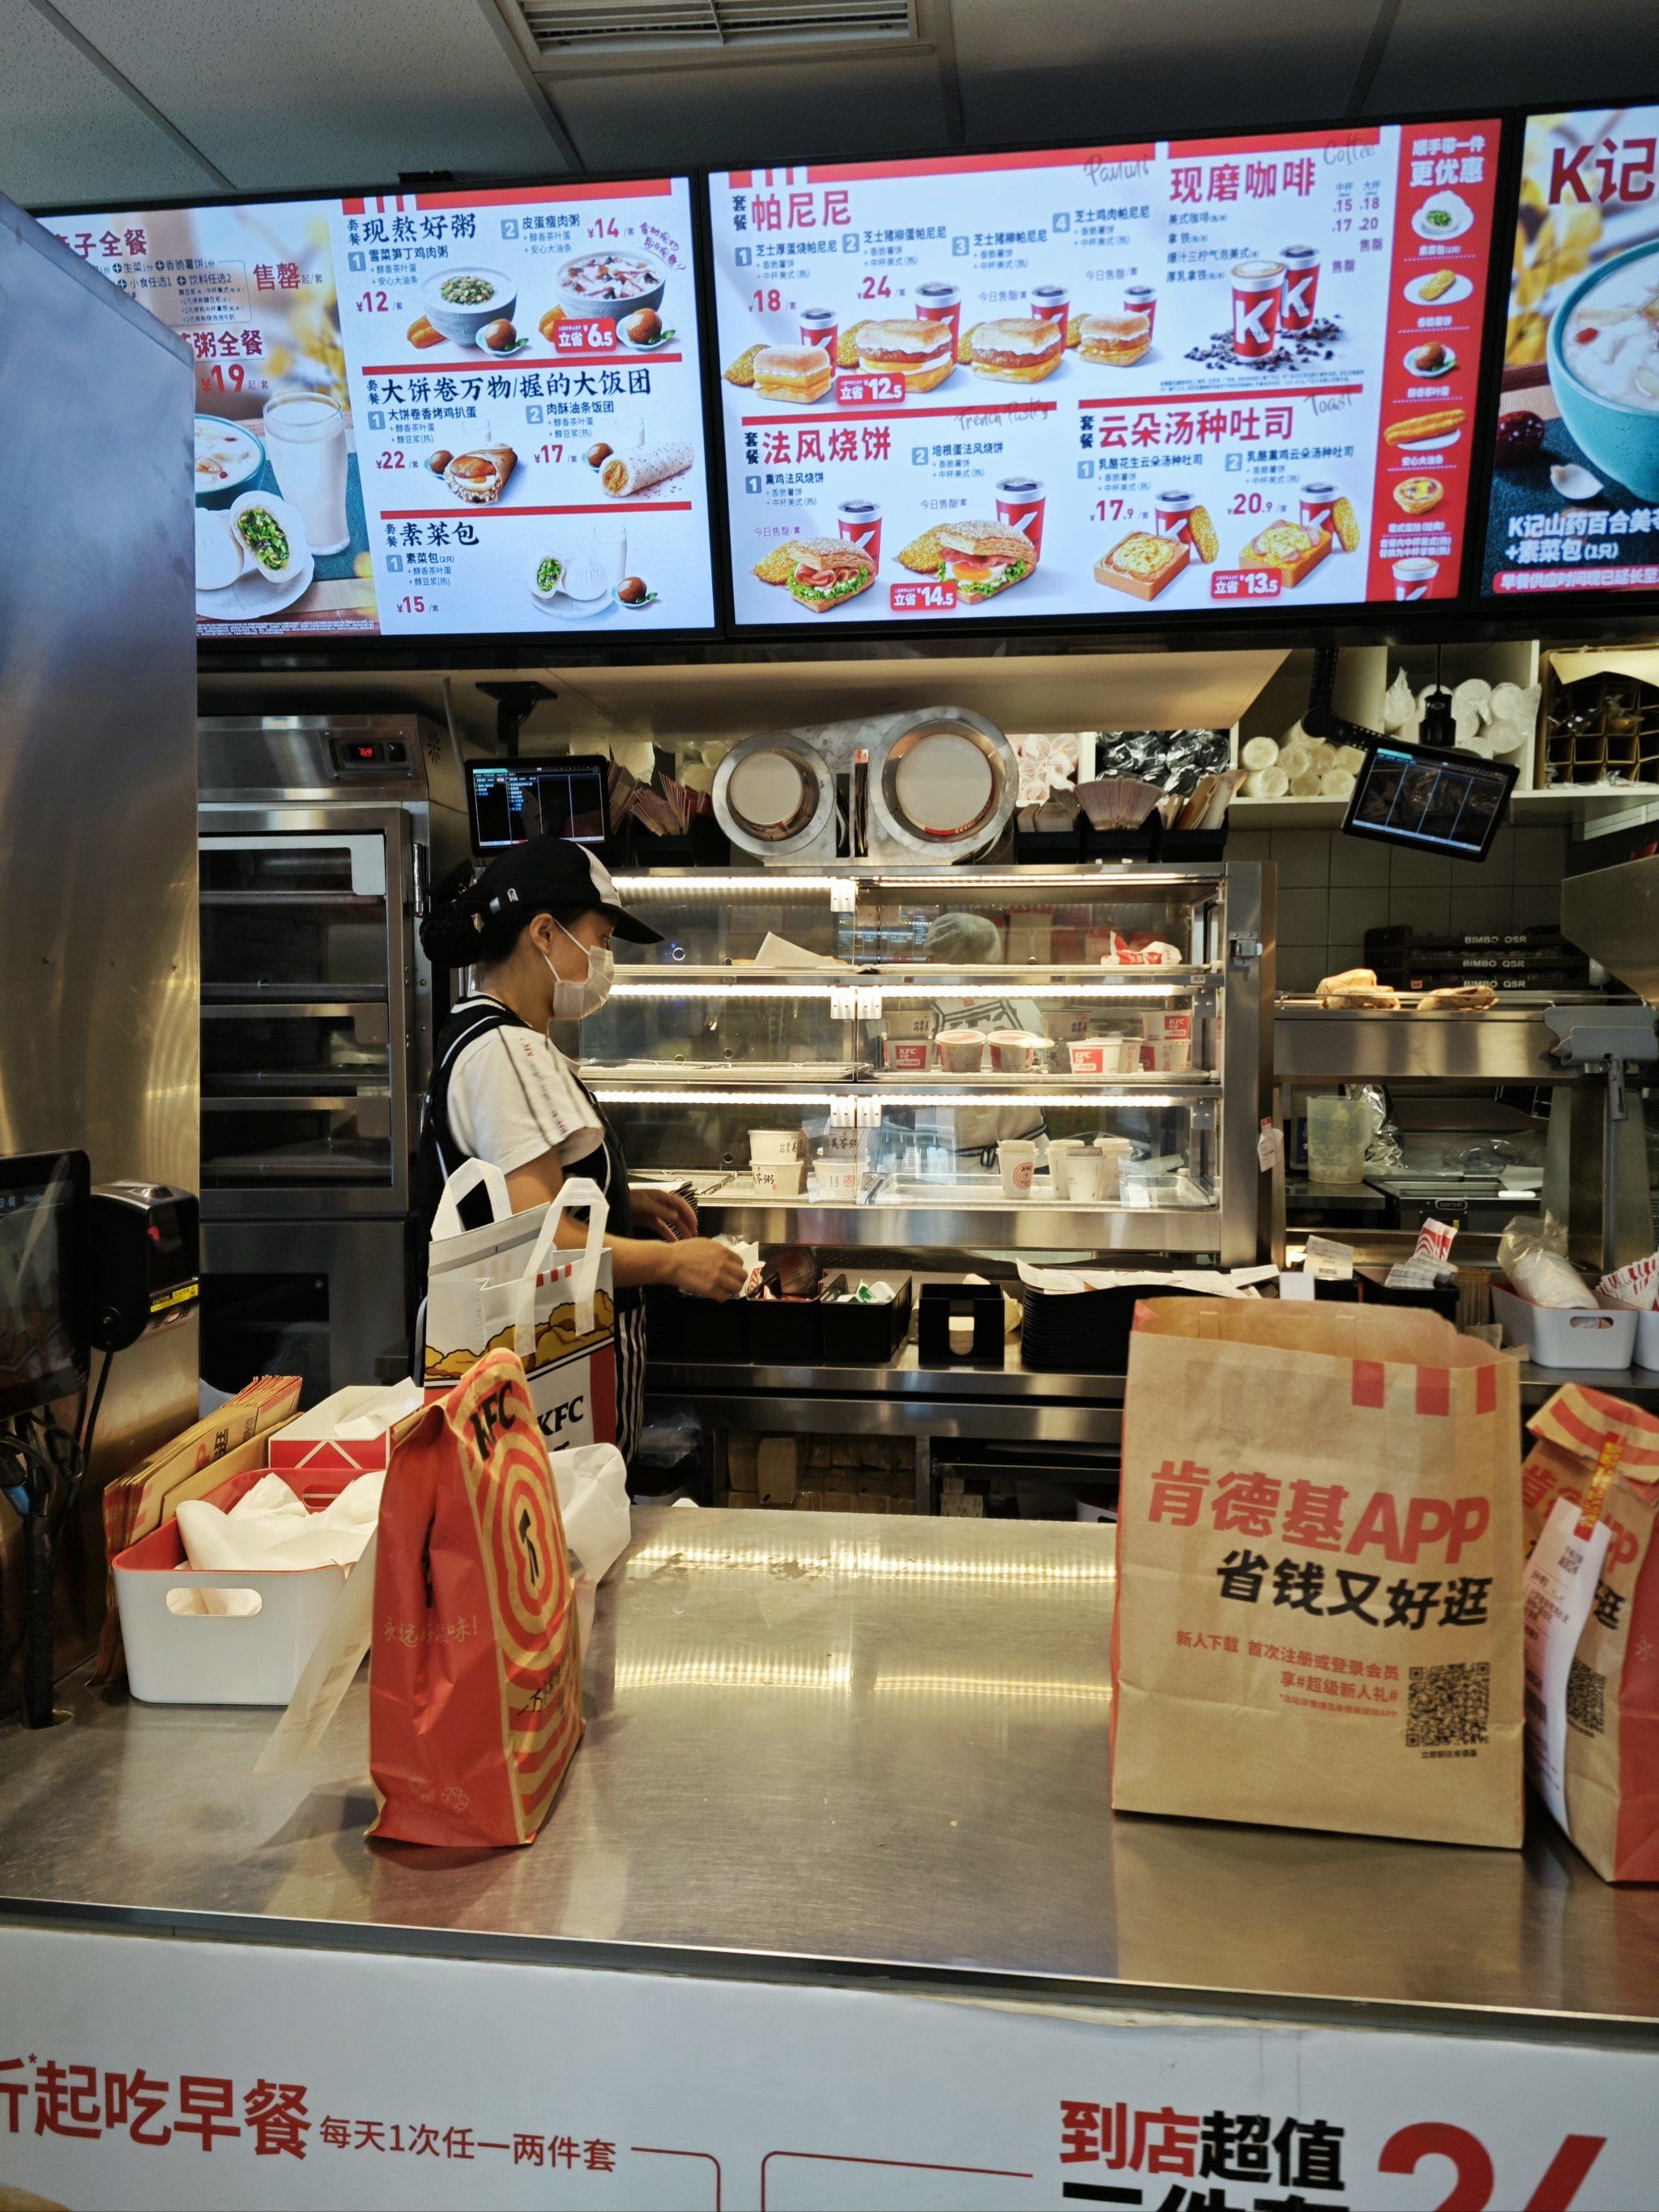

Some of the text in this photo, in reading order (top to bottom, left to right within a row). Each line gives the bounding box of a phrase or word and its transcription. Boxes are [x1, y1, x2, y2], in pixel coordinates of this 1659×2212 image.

[1323, 133, 1376, 166] Coffee
[1412, 135, 1486, 156] 顺手带一件
[1170, 157, 1316, 204] 现磨咖啡
[1410, 156, 1485, 187] 更优惠
[1549, 138, 1657, 205] K记
[522, 213, 581, 231] 皮蛋瘦肉粥
[732, 195, 747, 231] 套餐
[752, 190, 851, 232] 帕尼尼
[347, 219, 360, 245] 套餐
[362, 212, 476, 245] 现熬好粥
[587, 217, 620, 240] ¥14
[369, 245, 449, 262] 雪菜笋丁鸡肉粥
[253, 262, 300, 292] 售罄
[356, 291, 389, 313] ¥12
[181, 330, 262, 358] 粥全餐
[558, 331, 582, 347] 立省
[201, 364, 245, 394] ¥19
[367, 379, 380, 405] 套餐
[382, 367, 650, 404] 大饼卷万物/握的大饭团
[839, 386, 863, 400] 立省
[388, 406, 477, 421] 大饼卷香烤鸡扒蛋
[546, 400, 614, 415] 肉酥油条饭团
[954, 408, 1003, 431] French
[1080, 416, 1094, 450] 套餐
[1098, 406, 1294, 448] 云朵汤种吐司
[534, 444, 564, 464] ¥17
[744, 432, 759, 465] 套餐
[762, 425, 891, 465] 法风烧饼
[932, 441, 1004, 457] 培根蛋法风烧饼
[1247, 446, 1354, 462] 乳酪熏鸡云朵汤种吐司
[376, 450, 405, 471] ¥22
[1098, 454, 1203, 471] 乳酪花生云朵汤种吐司
[766, 472, 825, 485] 熏鸡法风烧饼
[386, 522, 398, 548] 套餐
[399, 521, 480, 547] 素菜包
[893, 593, 915, 607] 立省
[1214, 580, 1239, 594] 立省
[397, 595, 425, 614] ¥15
[1464, 936, 1499, 944] BIMBO
[1462, 960, 1525, 968] BIMBO QSR
[1463, 980, 1526, 988] BIMBO QSR
[537, 1395, 584, 1436] KFC
[1147, 1460, 1491, 1564] 肯德基APP
[1216, 1549, 1493, 1631] 省钱又好逛
[1176, 1630, 1400, 1681] 新人下载 首次注册或登录会员
[1280, 1669, 1399, 1703] 享#超级新人礼#
[319, 2115, 616, 2174] 每天1次任一两件套
[1060, 2100, 1346, 2191] 到店超值
